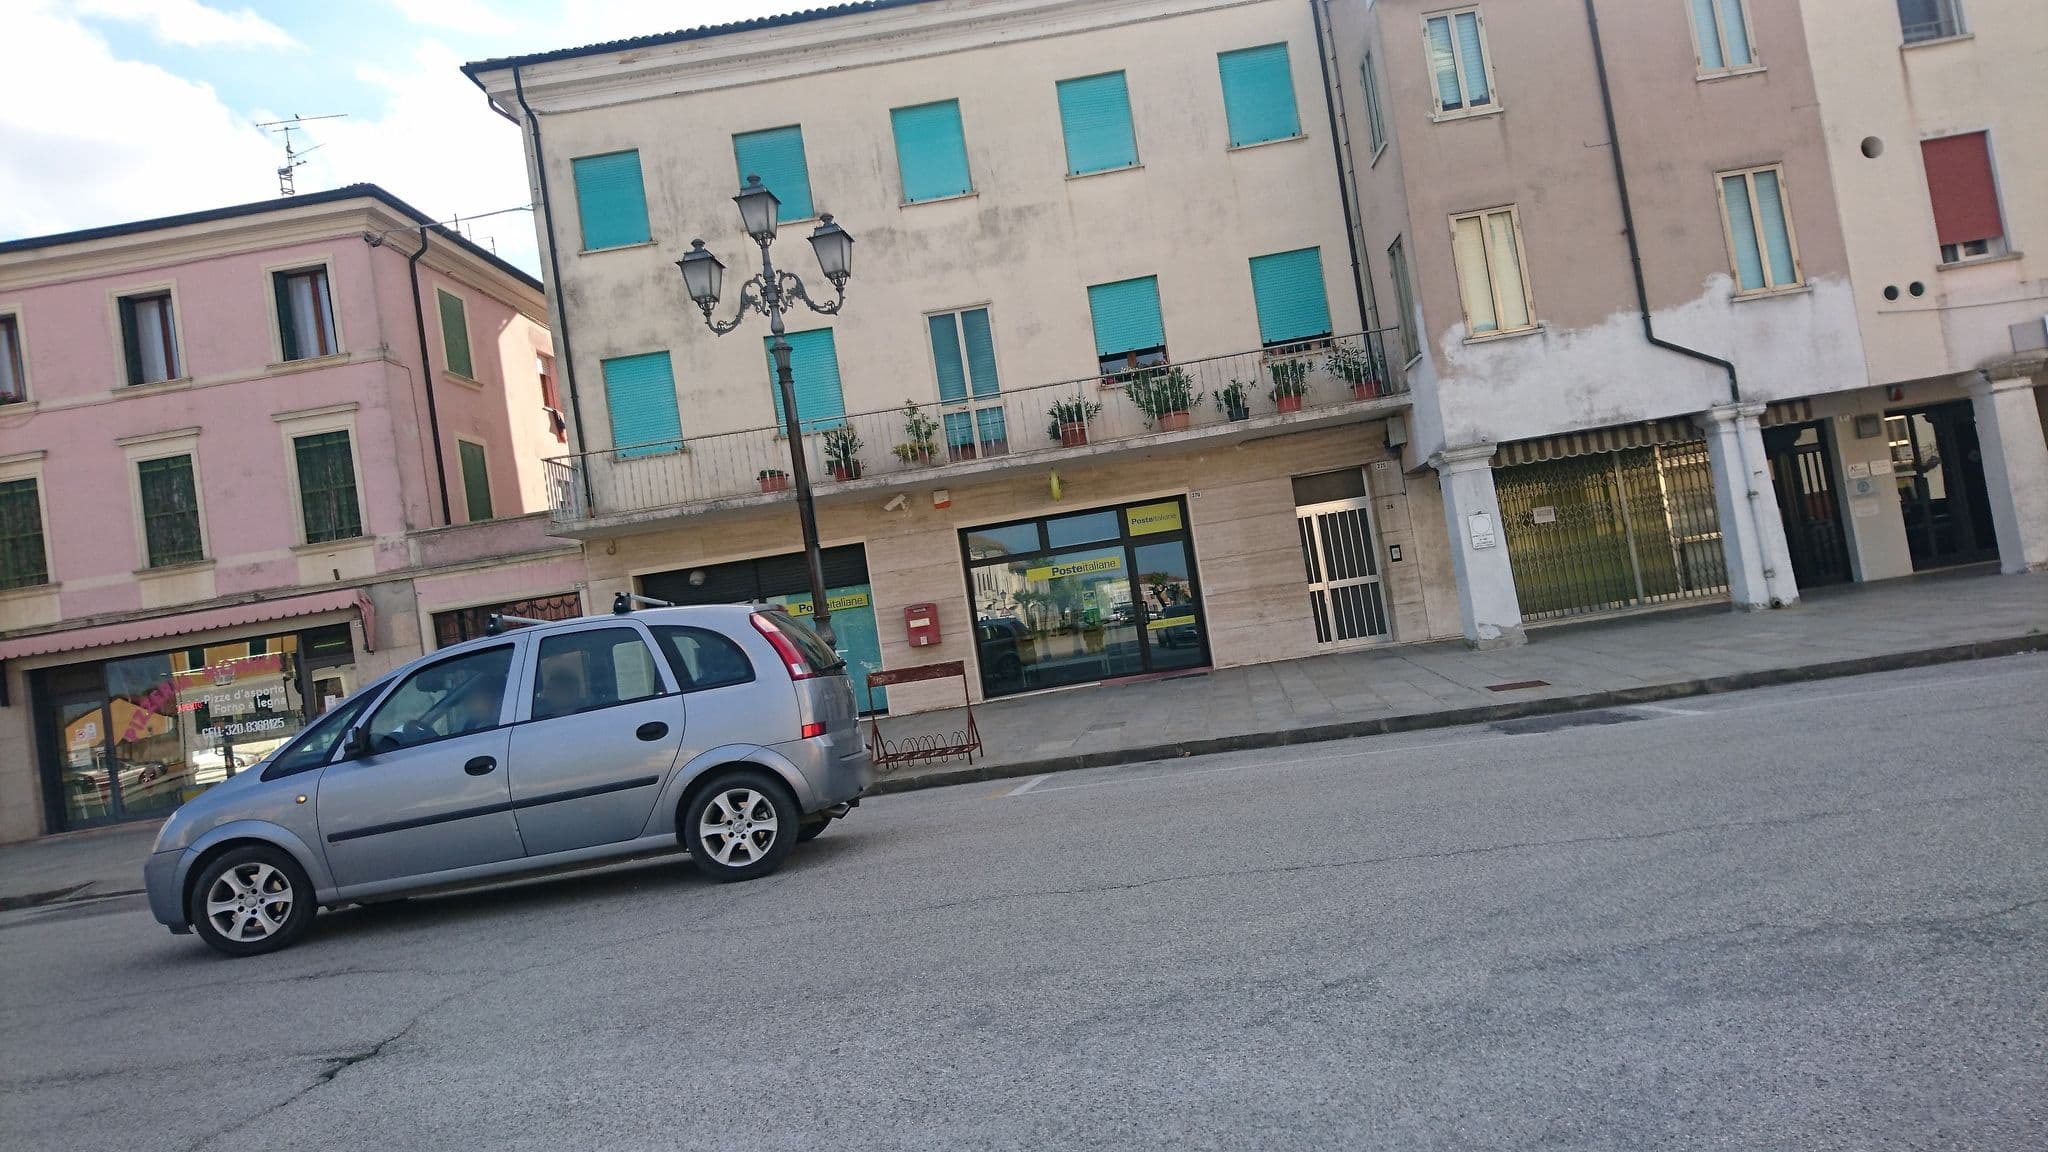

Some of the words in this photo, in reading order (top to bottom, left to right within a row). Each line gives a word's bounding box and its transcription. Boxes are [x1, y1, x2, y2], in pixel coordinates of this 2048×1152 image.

[1131, 513, 1177, 525] Posteitaliane
[1051, 560, 1116, 577] Posteitaliane
[798, 597, 864, 613] Poitaliane
[203, 693, 231, 704] Pizze
[233, 685, 285, 699] d'asporto
[214, 702, 246, 714] Forno
[257, 697, 287, 709] legna
